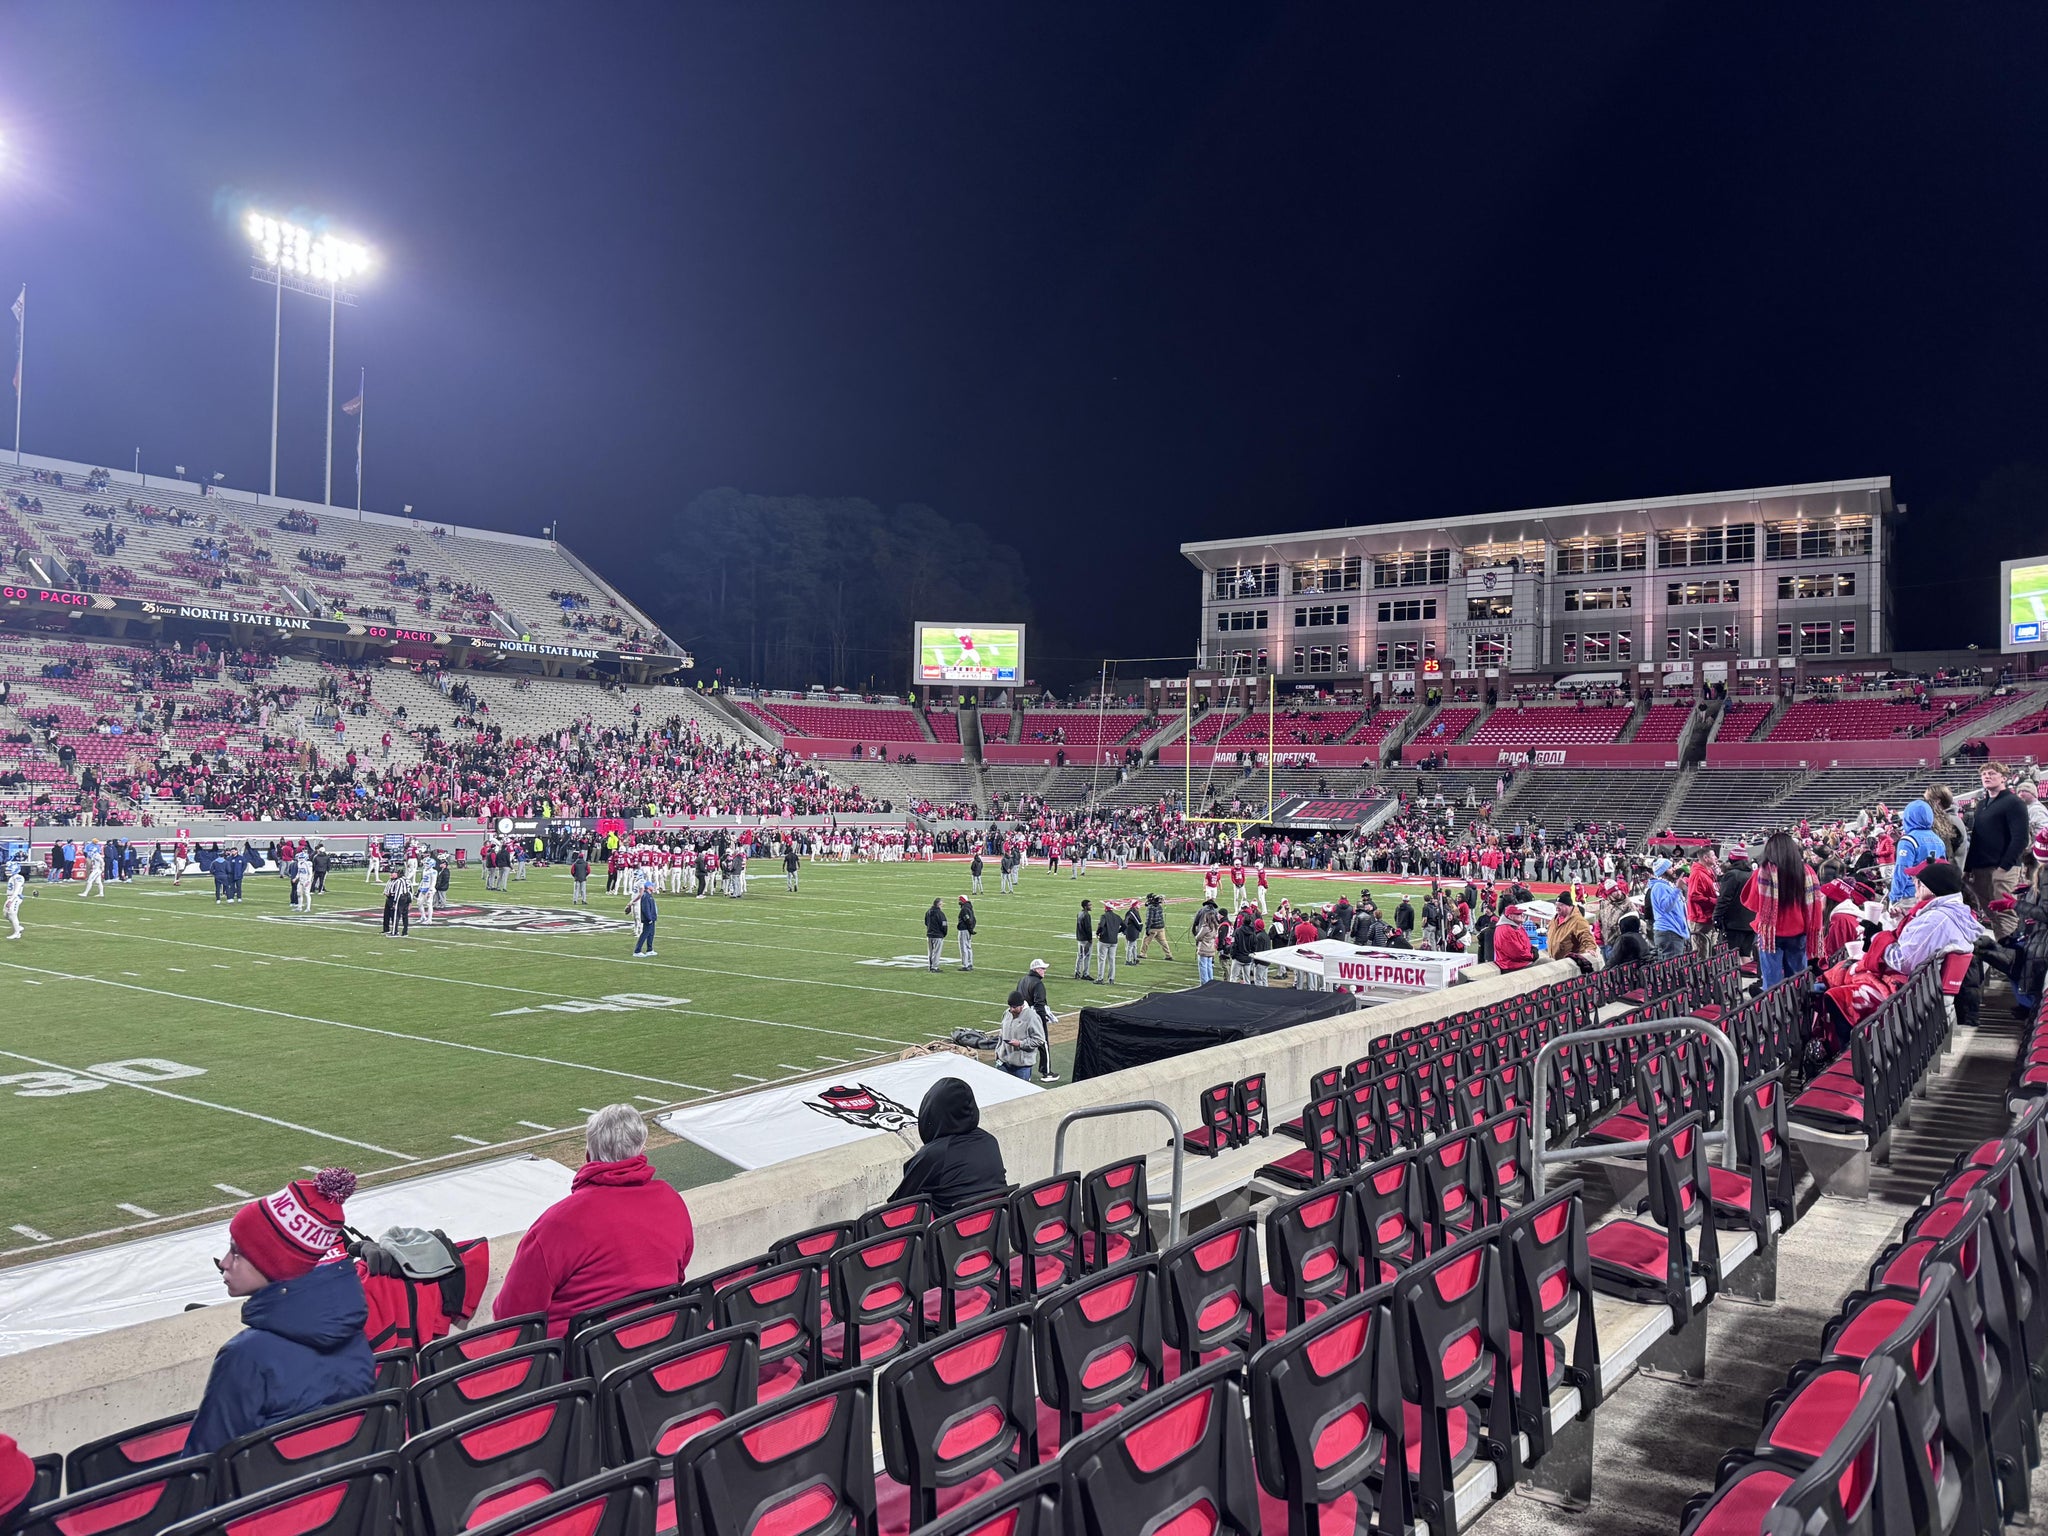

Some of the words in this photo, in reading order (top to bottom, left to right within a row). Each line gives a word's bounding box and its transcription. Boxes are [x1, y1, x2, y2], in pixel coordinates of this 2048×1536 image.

[3, 587, 28, 599] GO
[40, 591, 88, 606] PACK!
[141, 602, 156, 613] 25
[155, 605, 177, 614] Years
[180, 606, 230, 621] NORTH
[232, 612, 272, 626] STATE
[275, 617, 311, 630] BANK
[369, 627, 387, 637] GO
[396, 630, 431, 642] PACK!
[470, 638, 482, 647] 25
[500, 641, 537, 652] NORTH
[539, 645, 569, 656] STATE
[571, 649, 600, 659] BANK
[1424, 659, 1439, 671] 25
[1338, 962, 1426, 986] WOLFPACK
[0, 1058, 208, 1097] 30
[271, 1193, 295, 1218] NC
[289, 1215, 337, 1248] STATE
